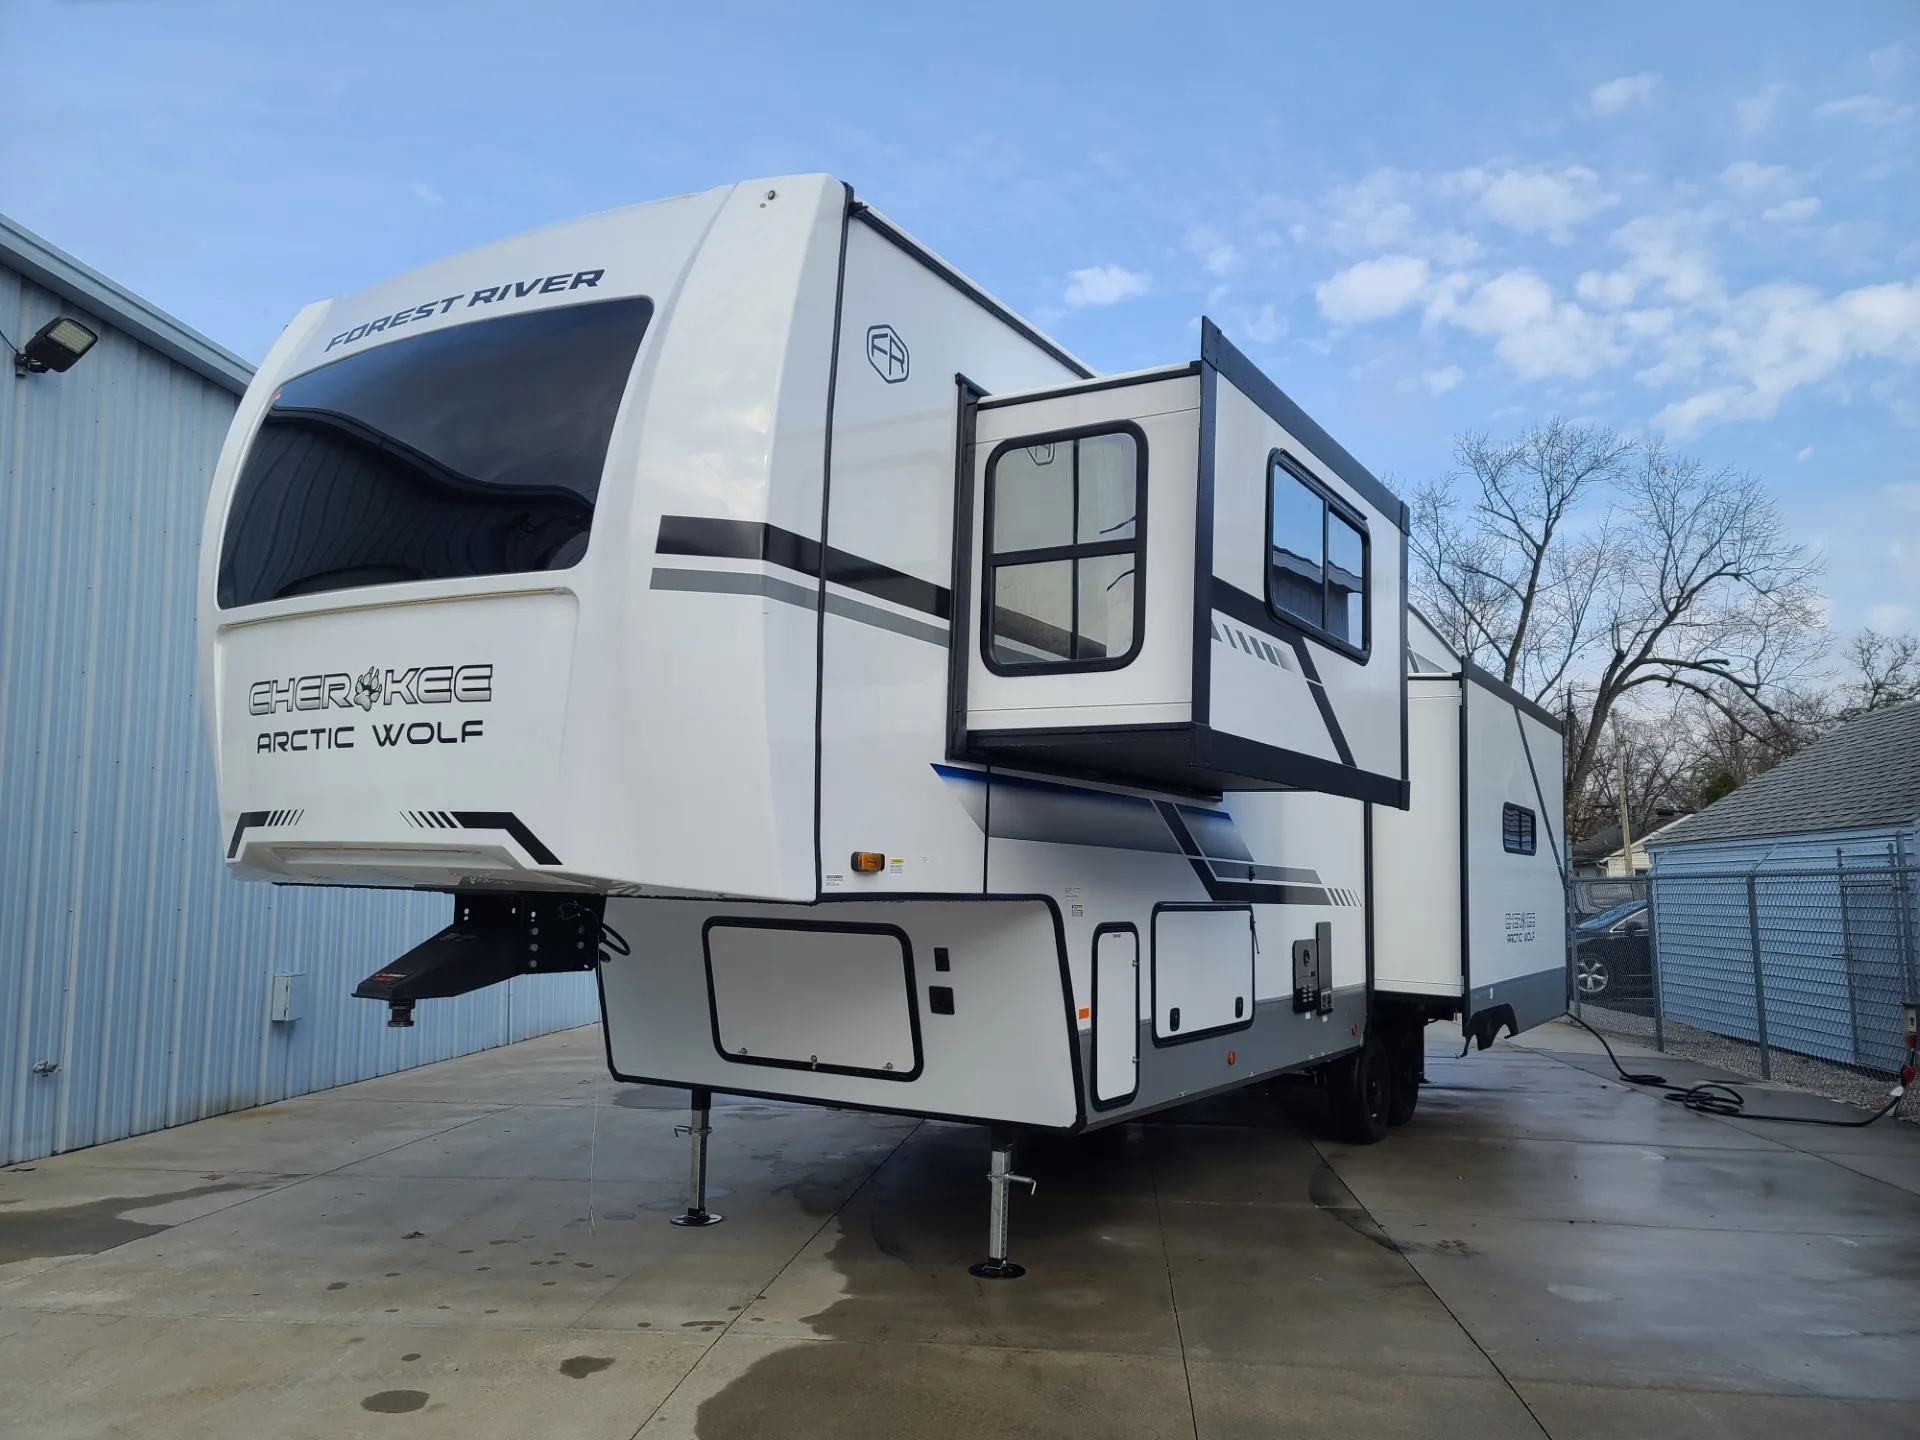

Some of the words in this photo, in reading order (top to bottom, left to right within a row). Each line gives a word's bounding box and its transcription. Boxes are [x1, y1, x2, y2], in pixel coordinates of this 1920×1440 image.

[324, 294, 464, 353] FOREST
[467, 268, 605, 307] RIVER
[257, 726, 355, 754] ARCTIC
[372, 720, 484, 747] WOLF
